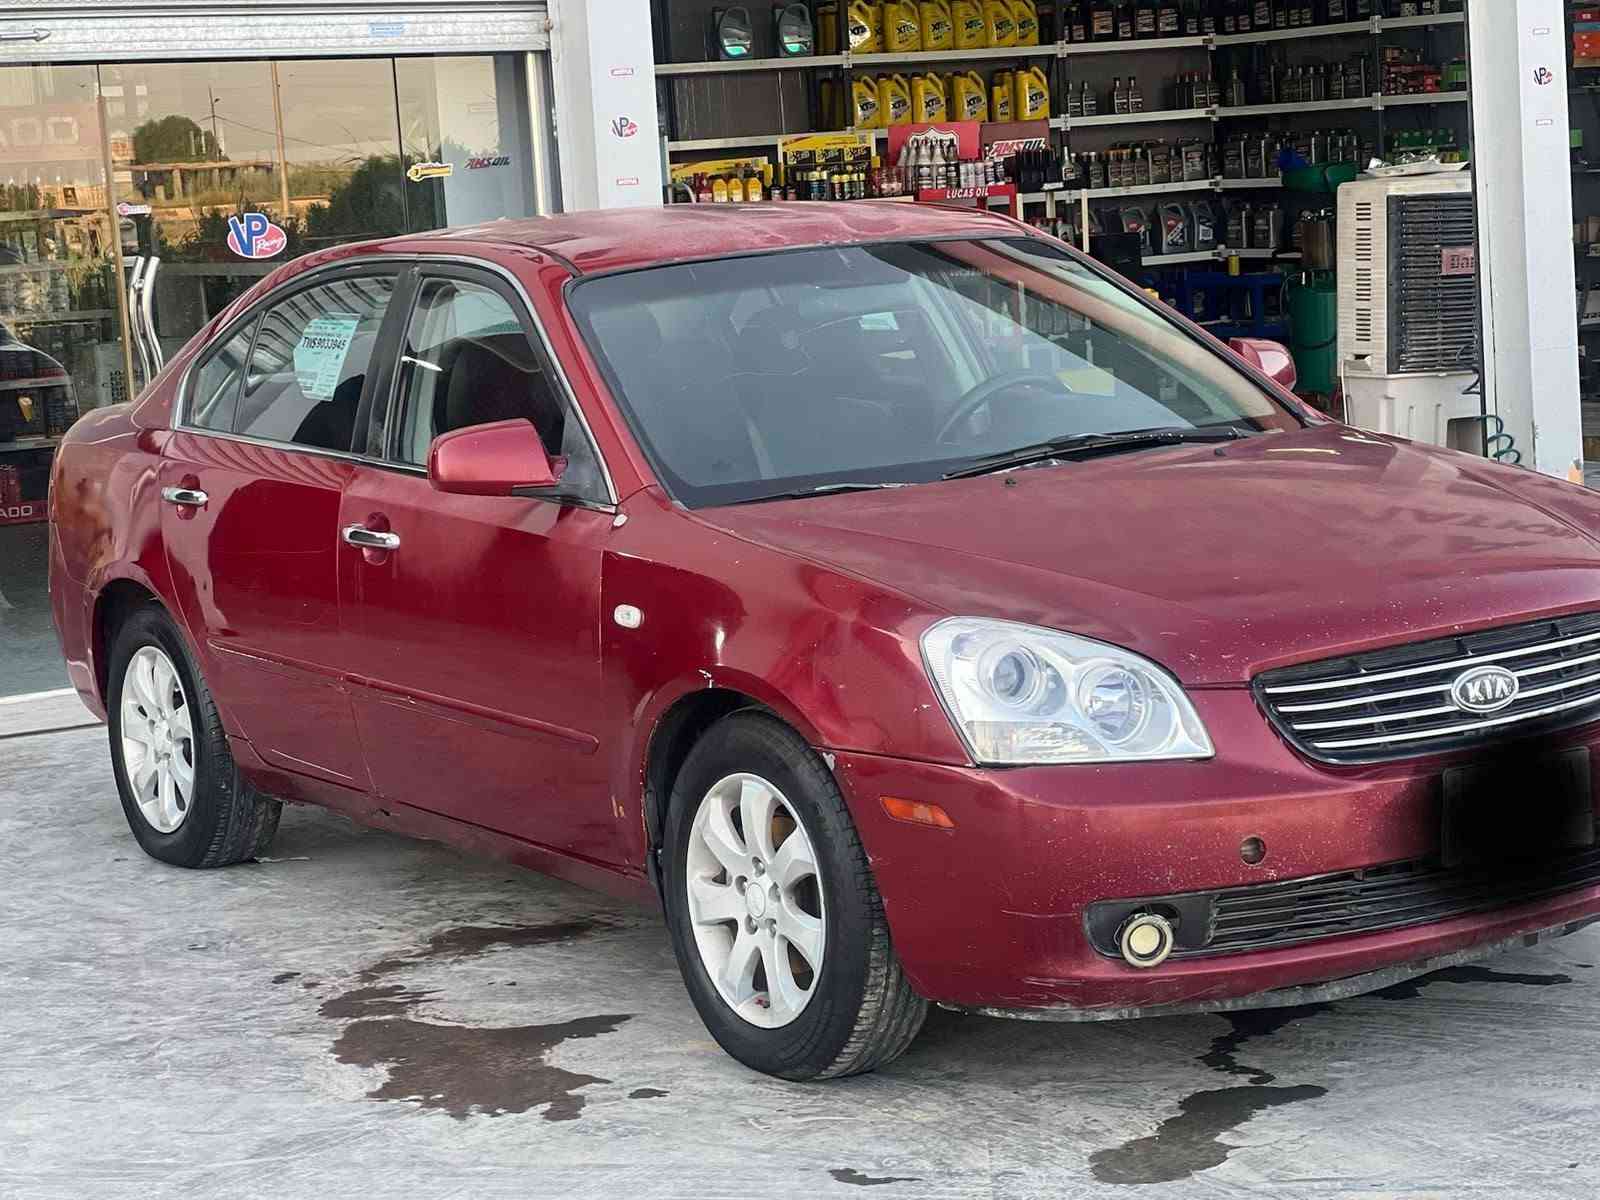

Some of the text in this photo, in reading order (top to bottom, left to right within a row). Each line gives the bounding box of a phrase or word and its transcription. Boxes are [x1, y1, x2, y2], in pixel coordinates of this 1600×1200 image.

[464, 157, 511, 169] AMSOIL
[946, 187, 989, 199] LUCAS OIL
[229, 213, 269, 257] VP
[1467, 677, 1511, 703] KIA
